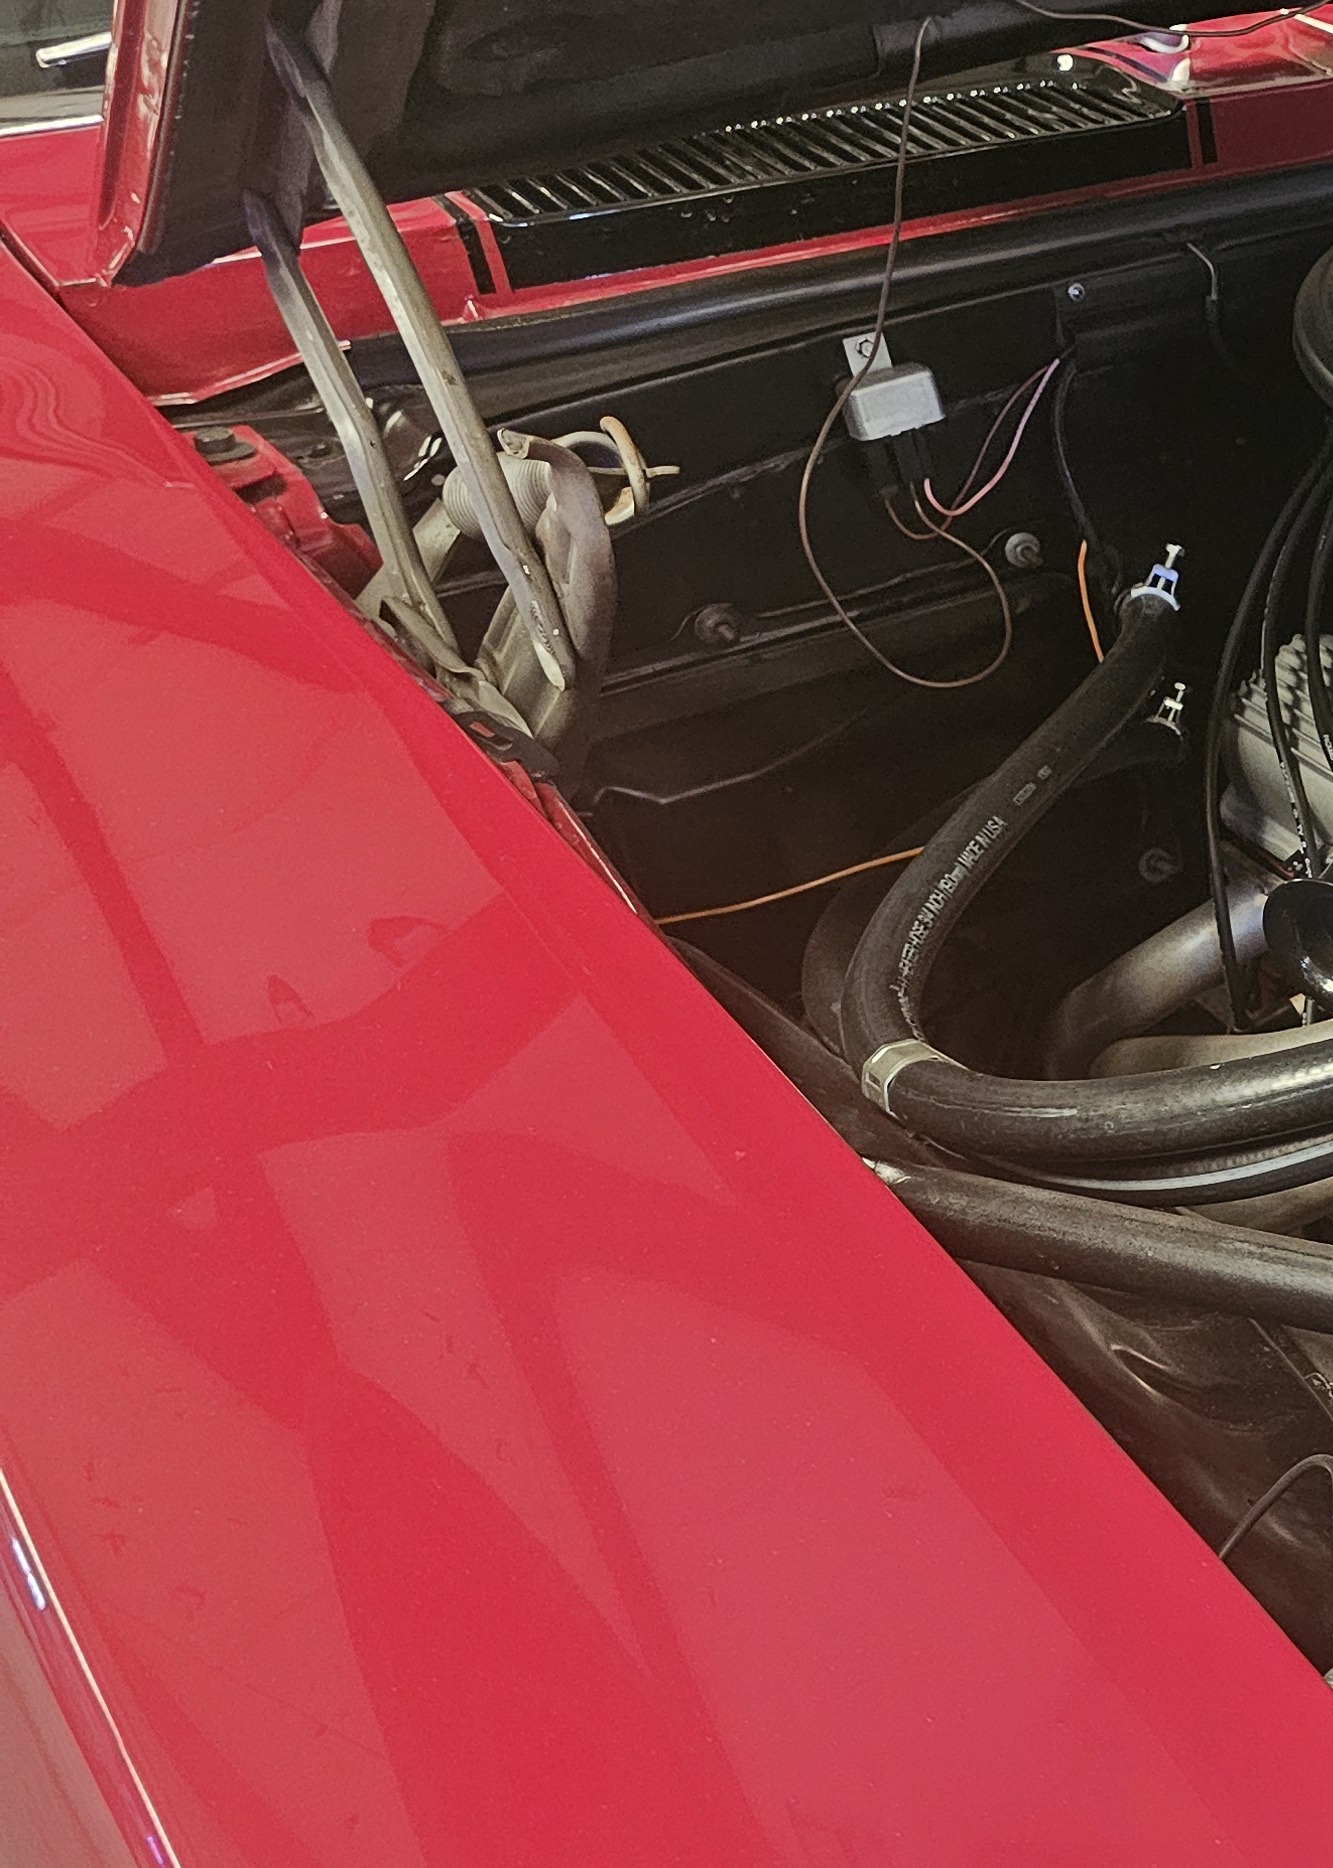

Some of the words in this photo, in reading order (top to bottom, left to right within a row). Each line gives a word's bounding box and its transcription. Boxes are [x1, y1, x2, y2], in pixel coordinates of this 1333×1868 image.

[982, 815, 1007, 839] USA
[974, 831, 992, 849] IN
[957, 840, 986, 870] MADE
